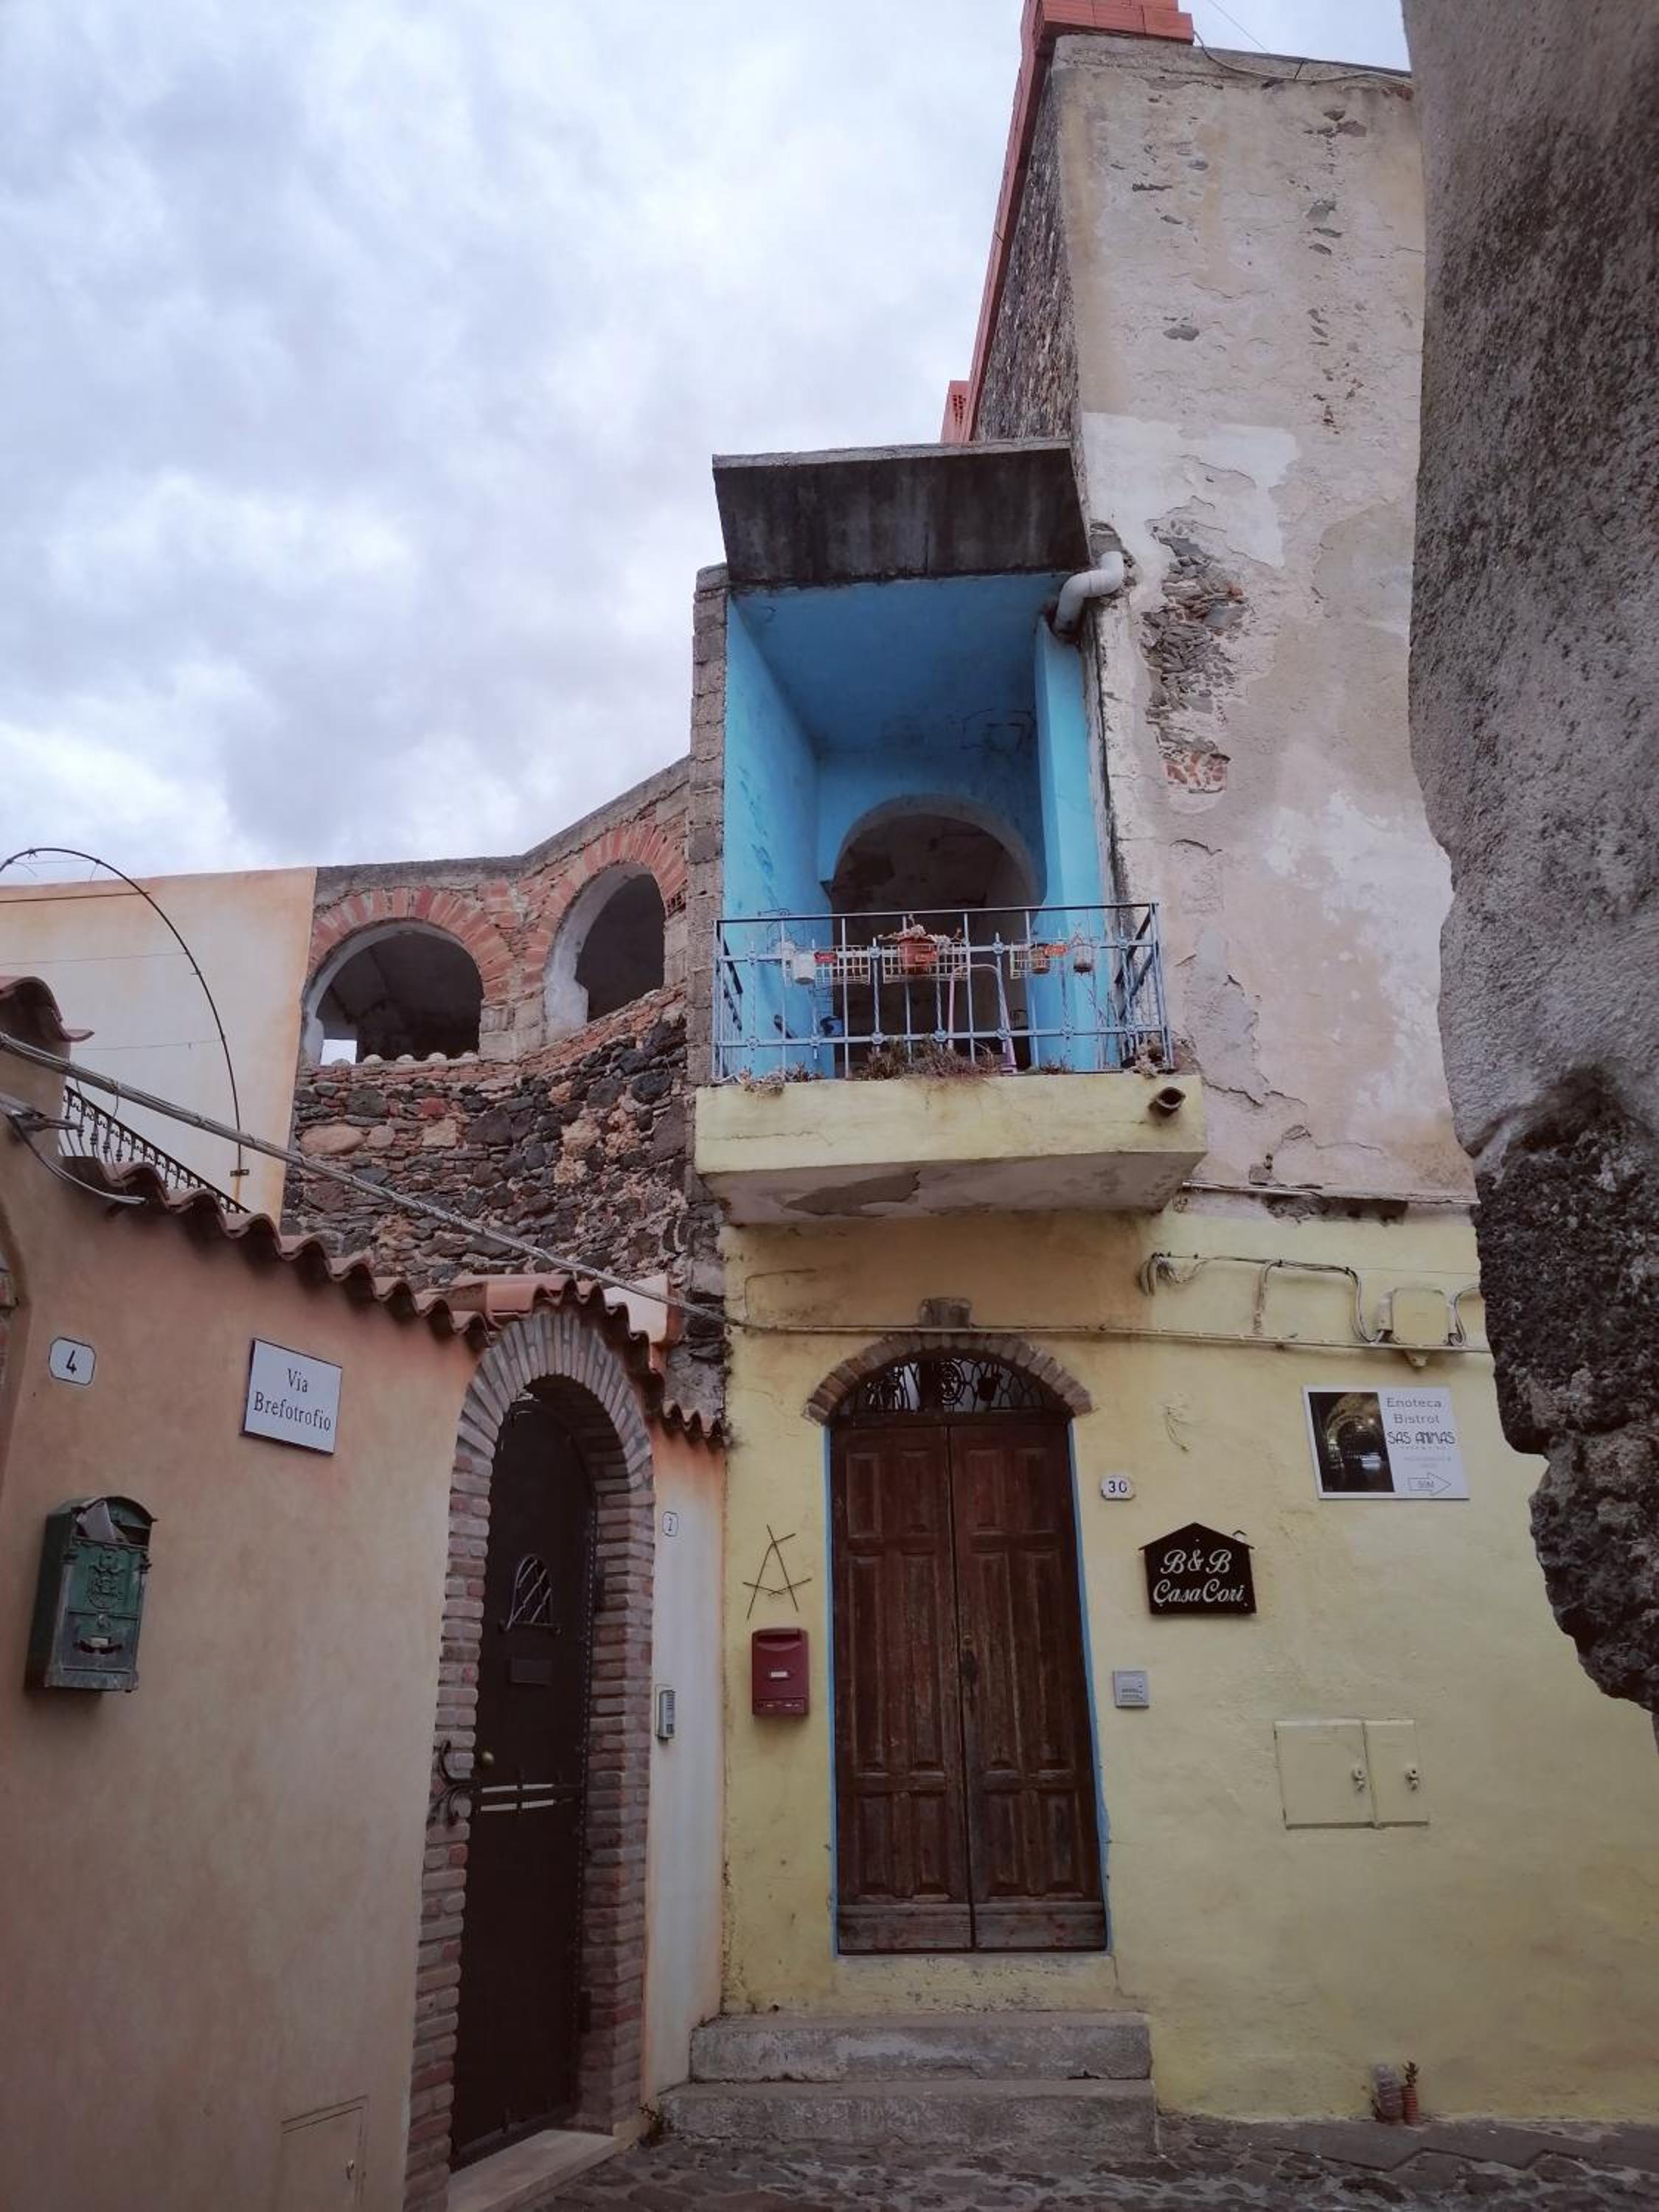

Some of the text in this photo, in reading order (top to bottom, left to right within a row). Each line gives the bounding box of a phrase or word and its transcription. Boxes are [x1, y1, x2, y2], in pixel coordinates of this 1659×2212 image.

[66, 1349, 77, 1375] 4
[287, 1368, 308, 1393] Via
[1386, 1397, 1442, 1408] Enoteca
[253, 1391, 332, 1431] Brefotrofio
[1393, 1413, 1440, 1425] Bistrot
[1386, 1430, 1411, 1445] SAS
[1107, 1480, 1128, 1494] 30
